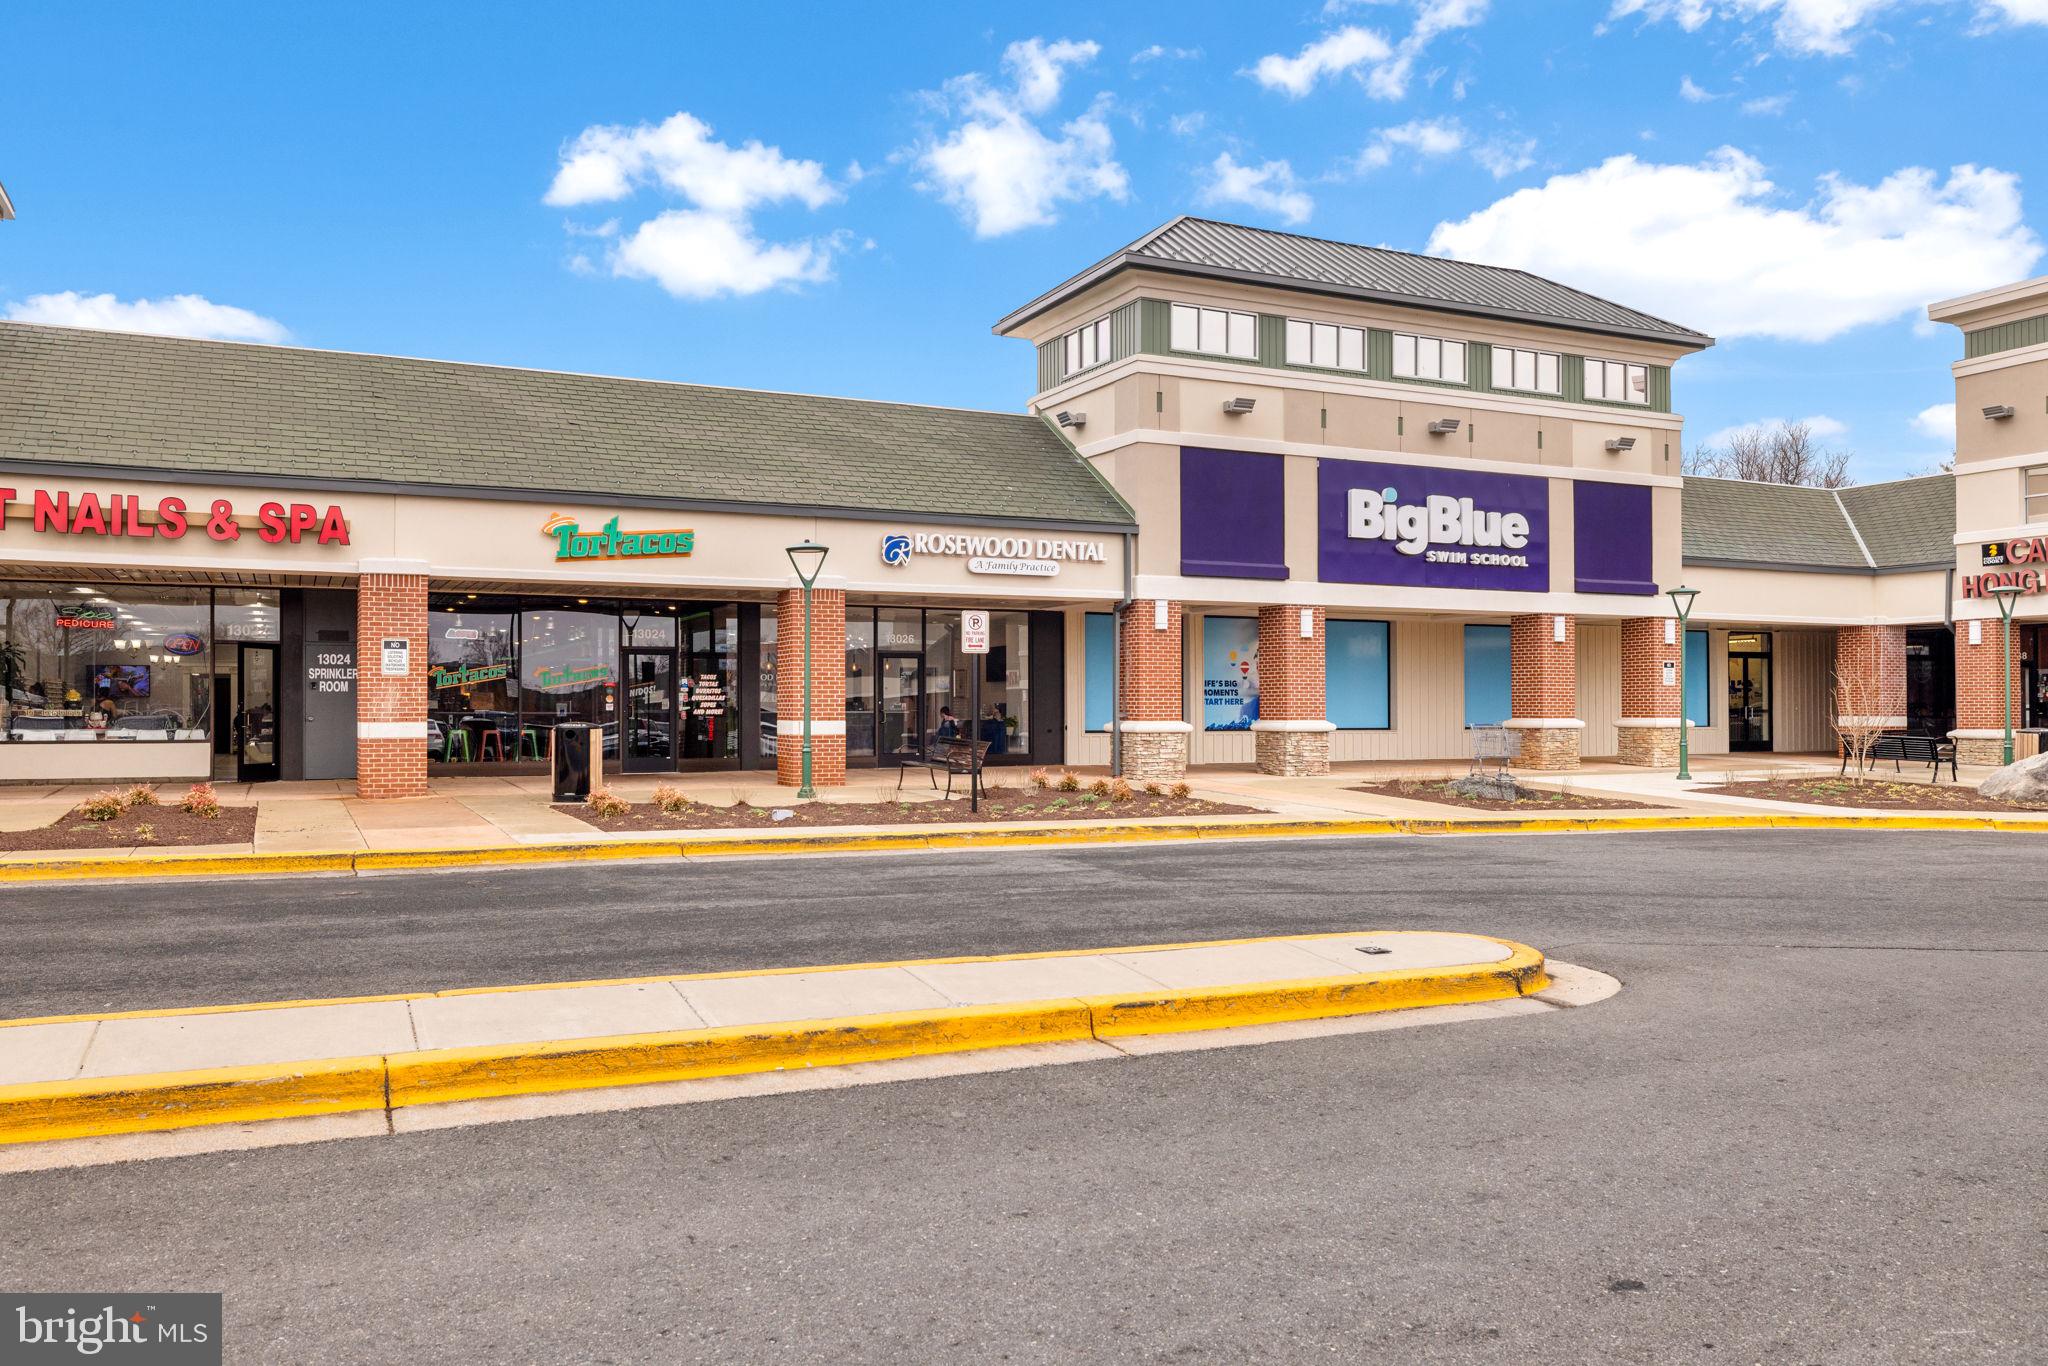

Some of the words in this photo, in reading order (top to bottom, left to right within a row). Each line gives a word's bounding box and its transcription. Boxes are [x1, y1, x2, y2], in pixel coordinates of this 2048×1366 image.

[34, 490, 188, 539] NAILS
[206, 499, 241, 542] &
[257, 502, 350, 546] SPA
[1348, 487, 1530, 555] BigBlue
[552, 515, 695, 558] Tortacos
[914, 532, 1033, 558] ROSEWOOD
[1036, 539, 1108, 562] DENTAL
[2006, 536, 2048, 565] CA
[1426, 550, 1467, 564] SWIM
[1470, 552, 1529, 567] SCHOOL
[974, 560, 984, 570] A
[984, 561, 1018, 573] Family
[1019, 562, 1056, 572] Practice
[1962, 569, 2040, 598] HONG
[62, 607, 114, 619] Spa
[56, 620, 114, 629] PEDICURE
[633, 629, 665, 639] 13024
[165, 638, 201, 652] OPEN
[317, 654, 351, 665] 13024
[308, 668, 358, 680] SPRINKLER
[319, 681, 348, 692] ROOM
